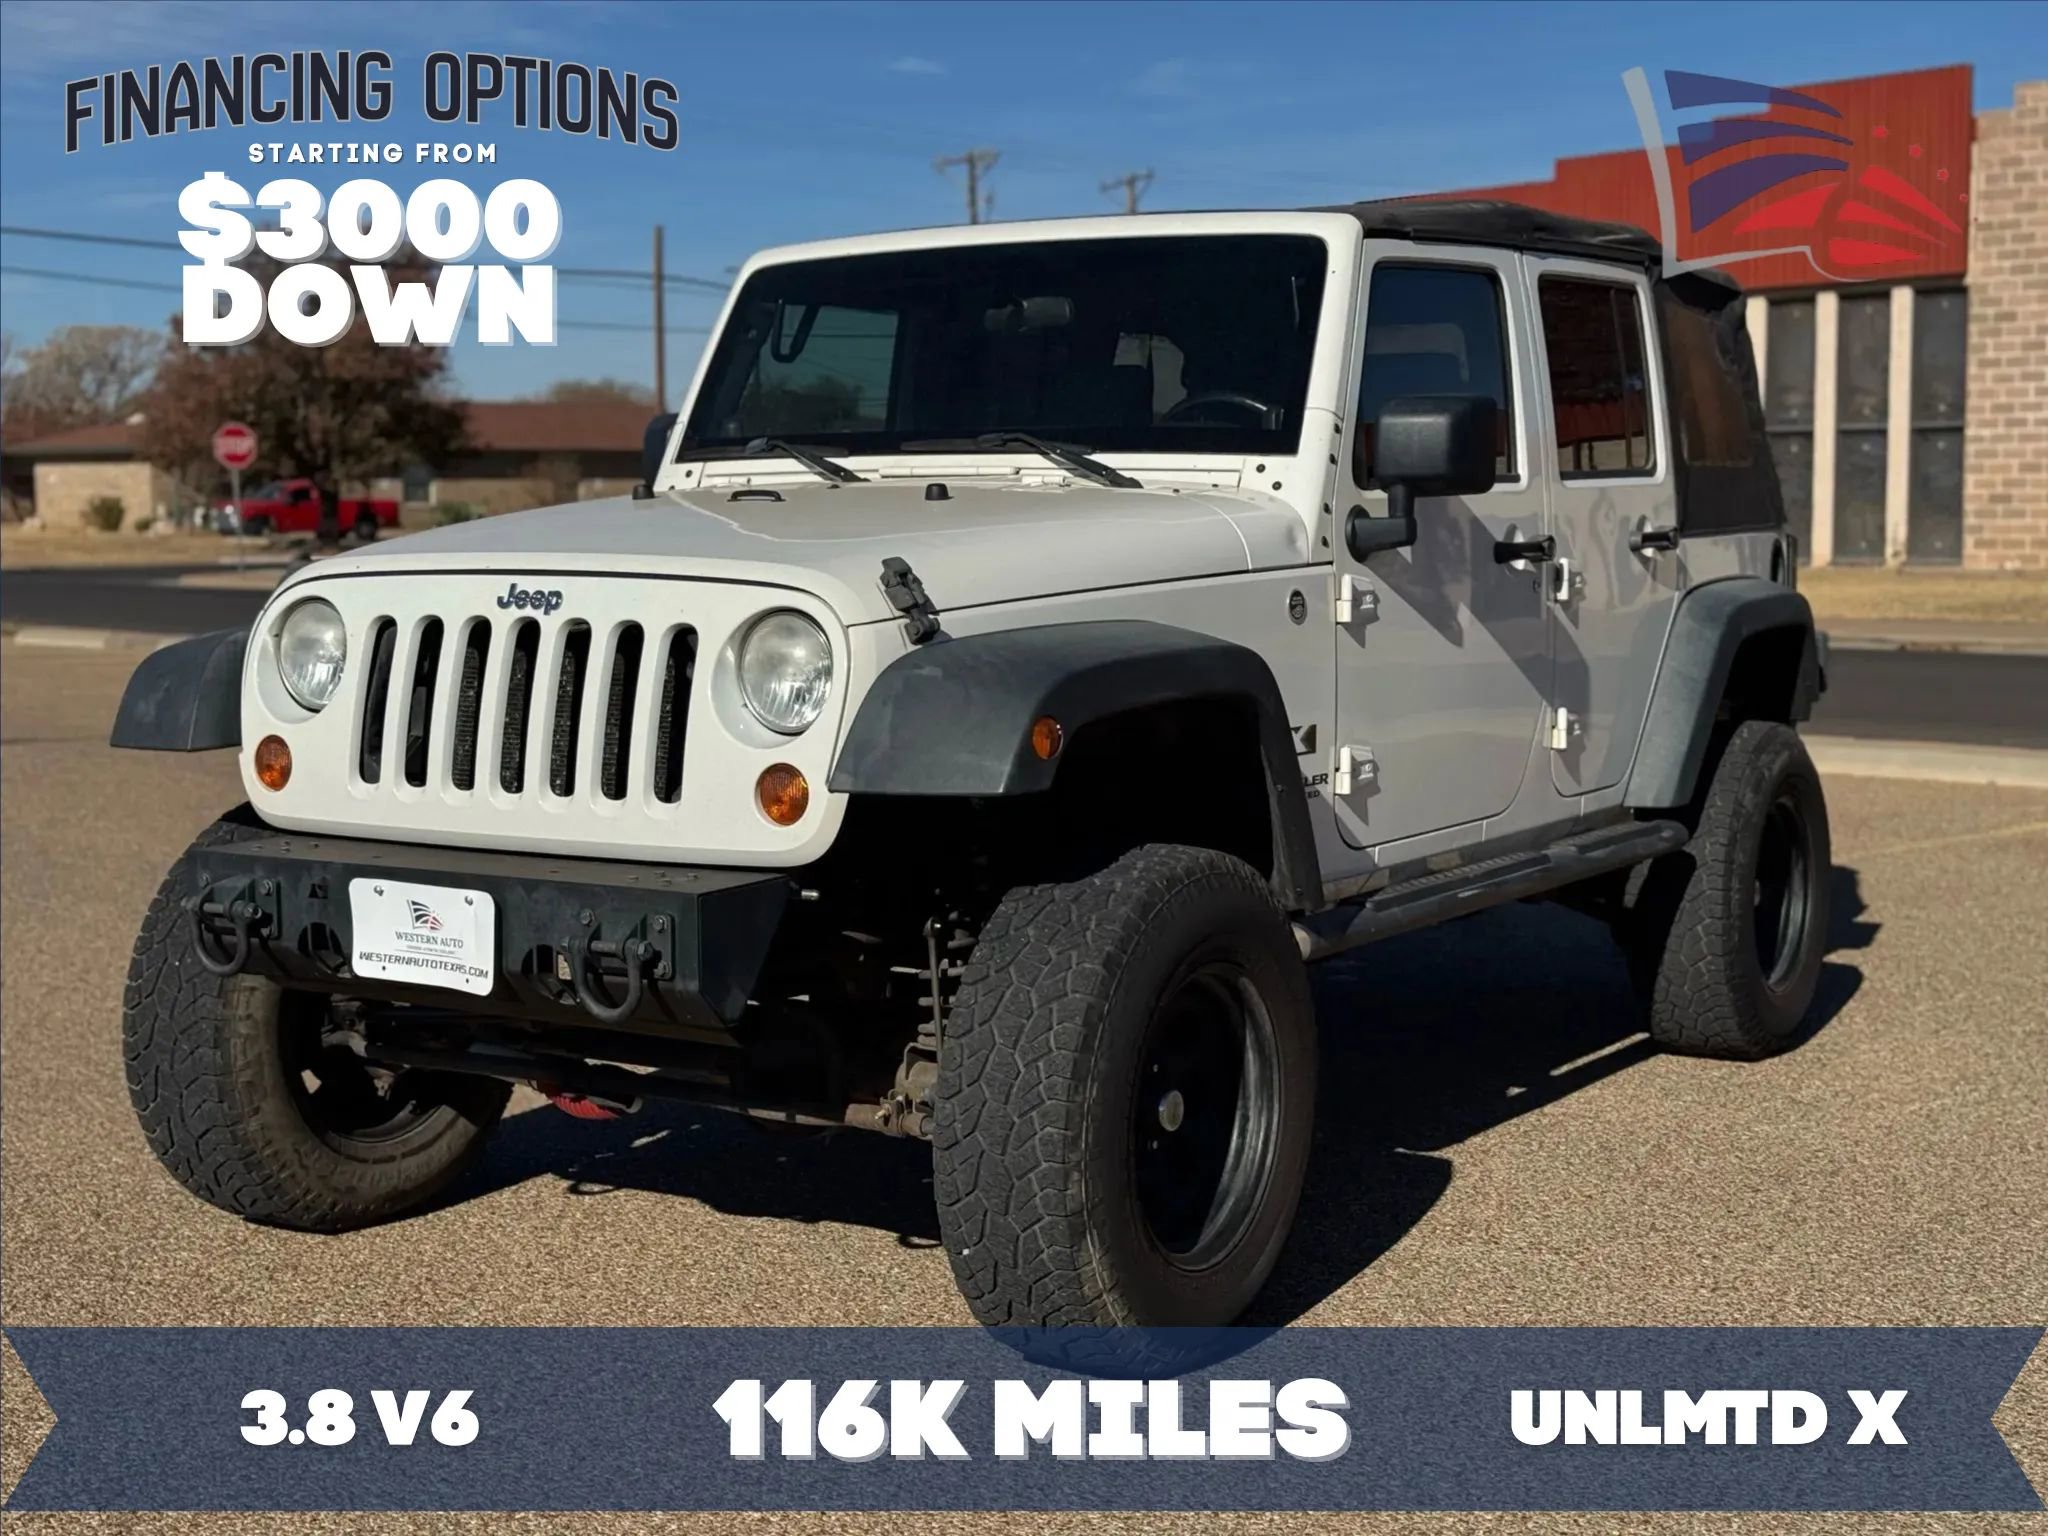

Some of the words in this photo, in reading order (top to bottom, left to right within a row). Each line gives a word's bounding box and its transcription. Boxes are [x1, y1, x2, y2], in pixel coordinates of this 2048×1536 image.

[496, 583, 563, 615] Jeep
[1303, 773, 1329, 787] LER
[1307, 790, 1321, 799] ED
[395, 931, 438, 949] WESTERN
[440, 937, 464, 949] AUTO
[359, 951, 489, 979] WESTERNAUTOTEXAS.COM
